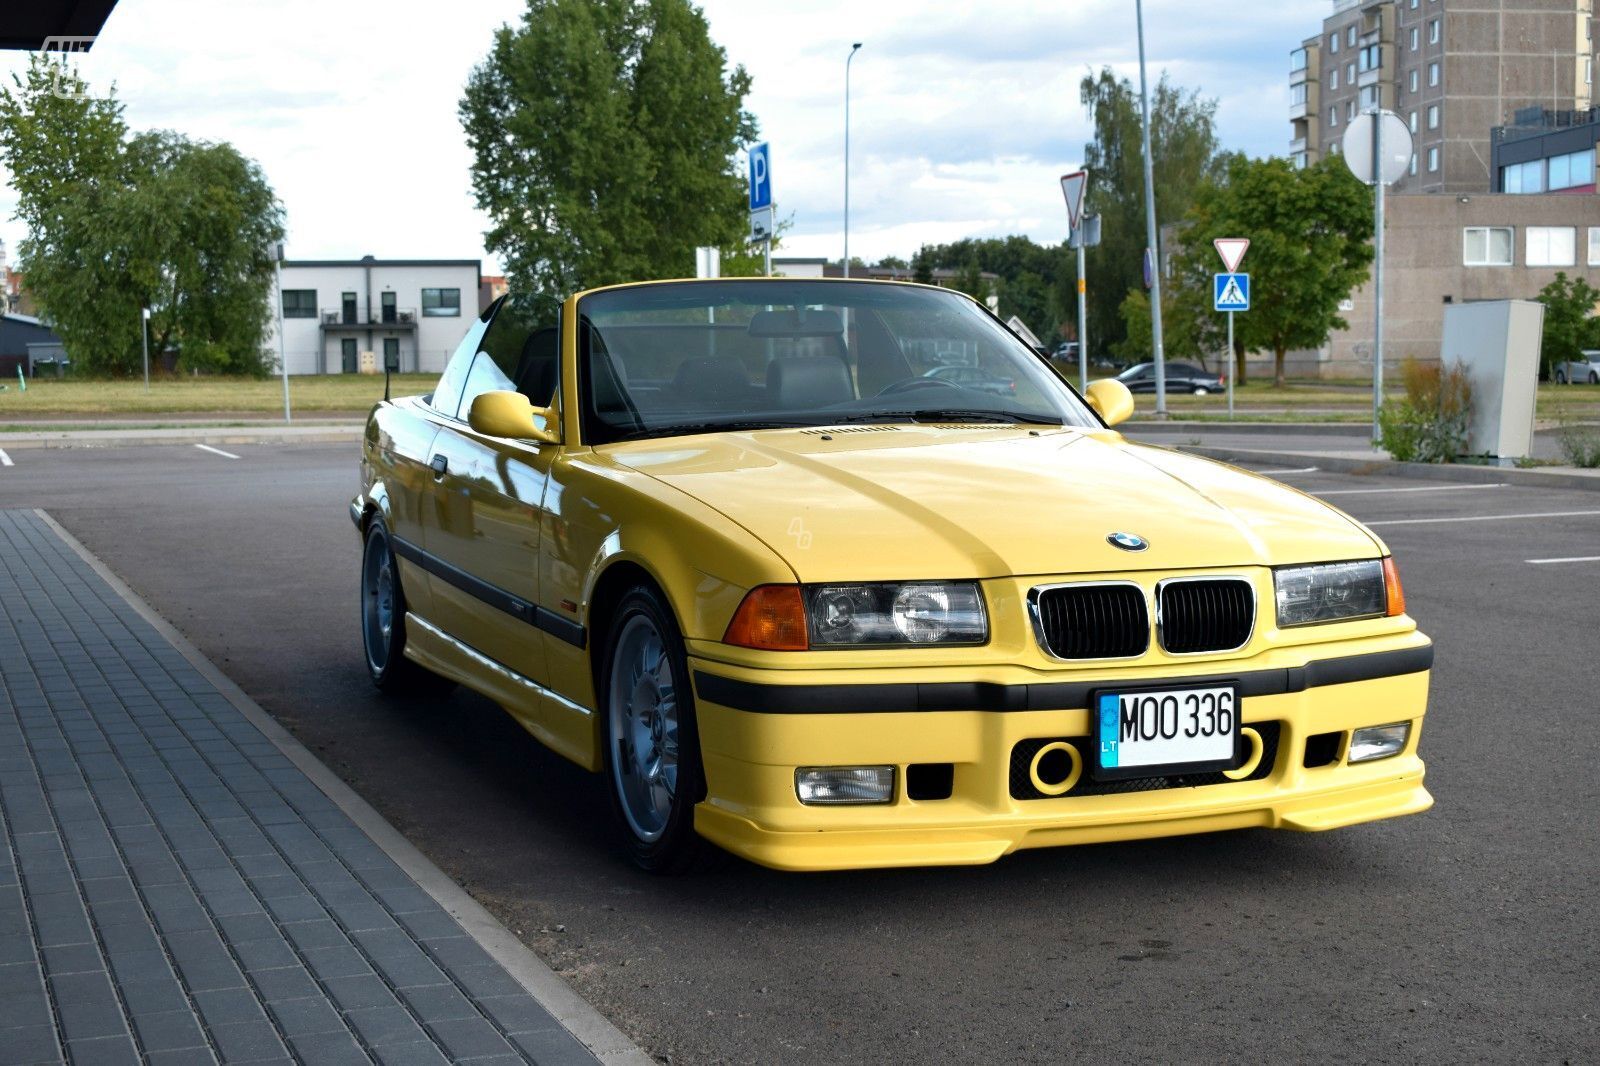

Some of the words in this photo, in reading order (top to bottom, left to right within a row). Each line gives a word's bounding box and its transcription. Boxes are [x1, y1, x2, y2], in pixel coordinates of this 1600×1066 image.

[754, 151, 767, 203] P
[1119, 694, 1179, 743] MOO
[1184, 691, 1232, 738] 336
[1101, 740, 1117, 753] LT
